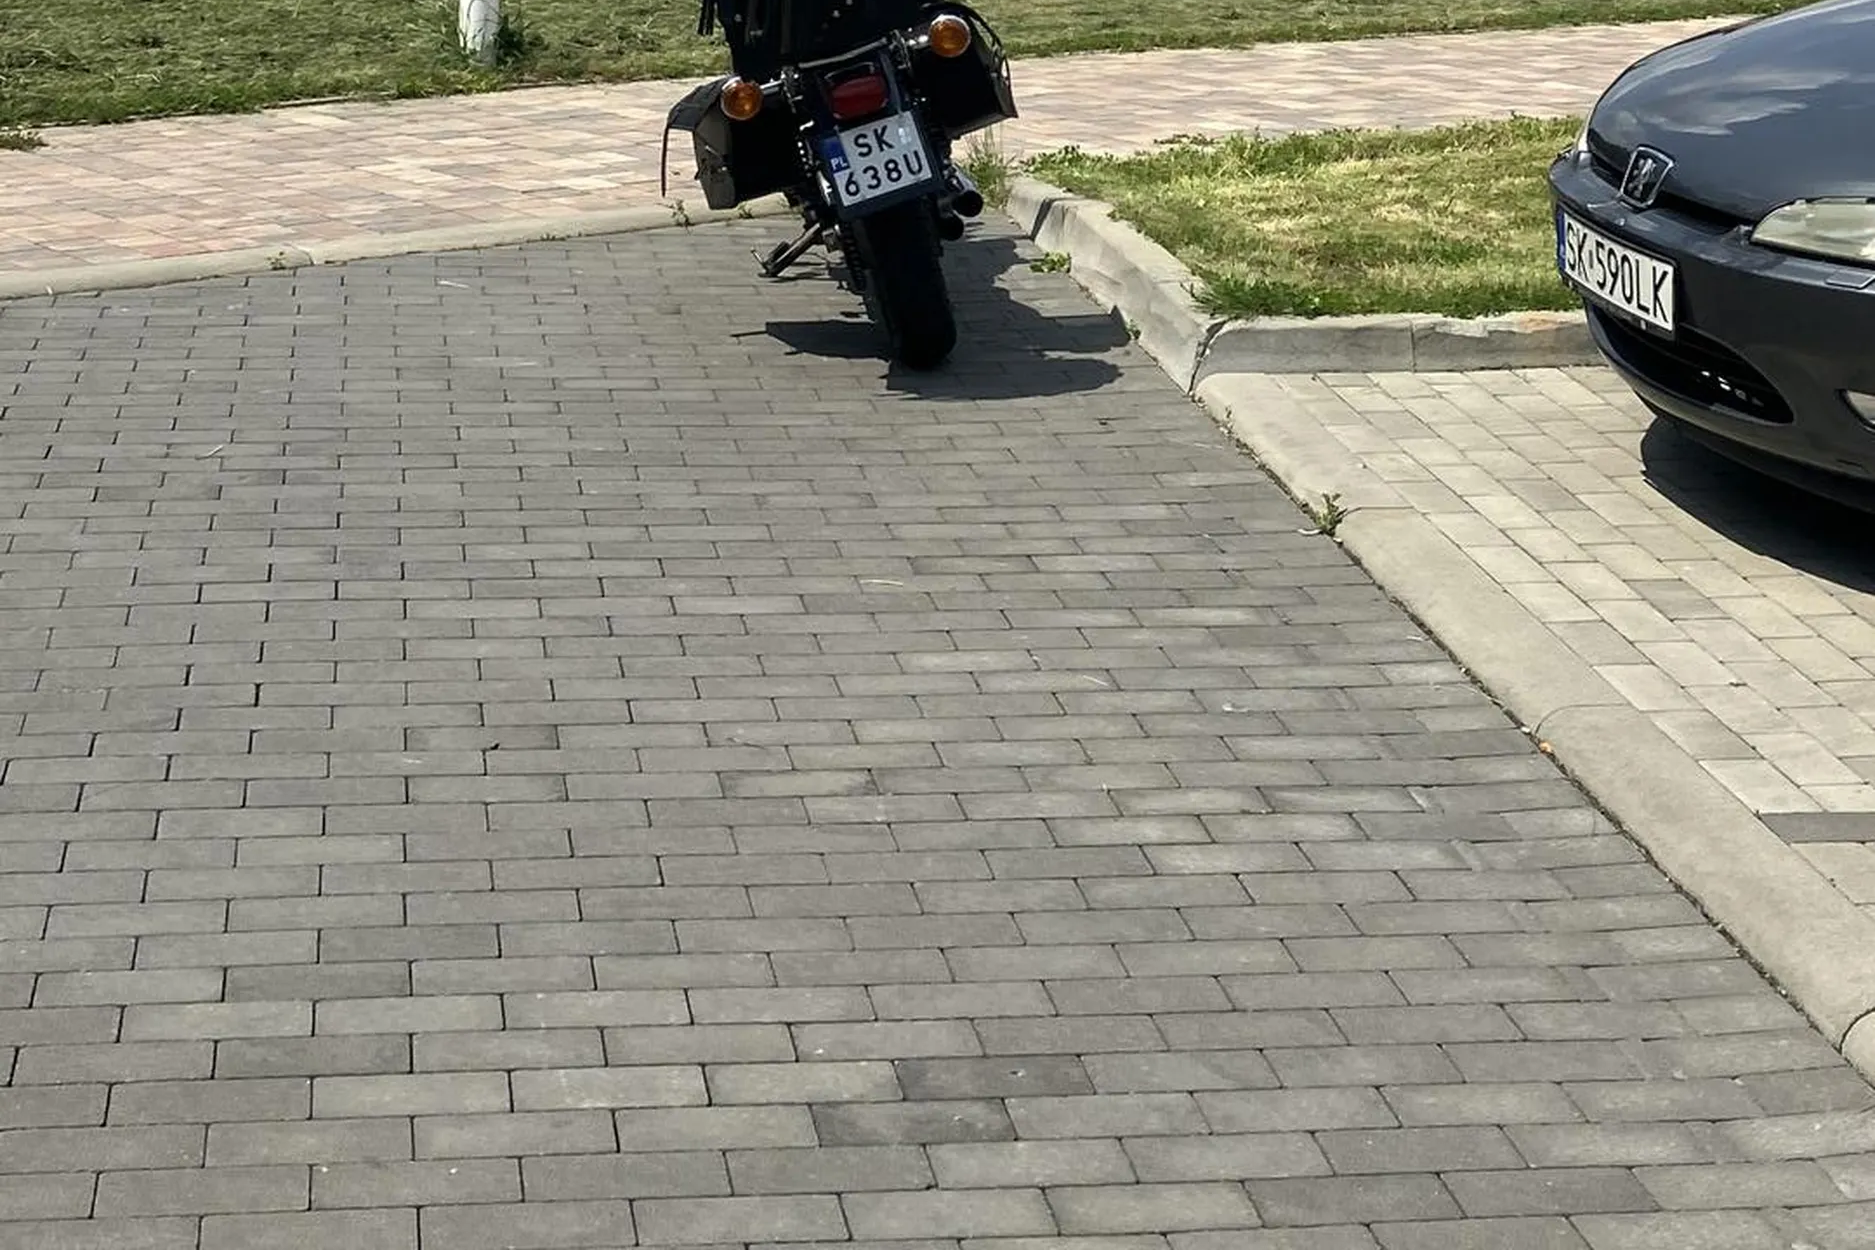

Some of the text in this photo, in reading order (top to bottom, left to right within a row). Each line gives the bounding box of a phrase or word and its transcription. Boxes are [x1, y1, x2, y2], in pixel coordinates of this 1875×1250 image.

[853, 124, 895, 158] SK
[830, 156, 848, 170] PL
[845, 150, 923, 197] 638U
[1567, 222, 1669, 324] SK 590LK
